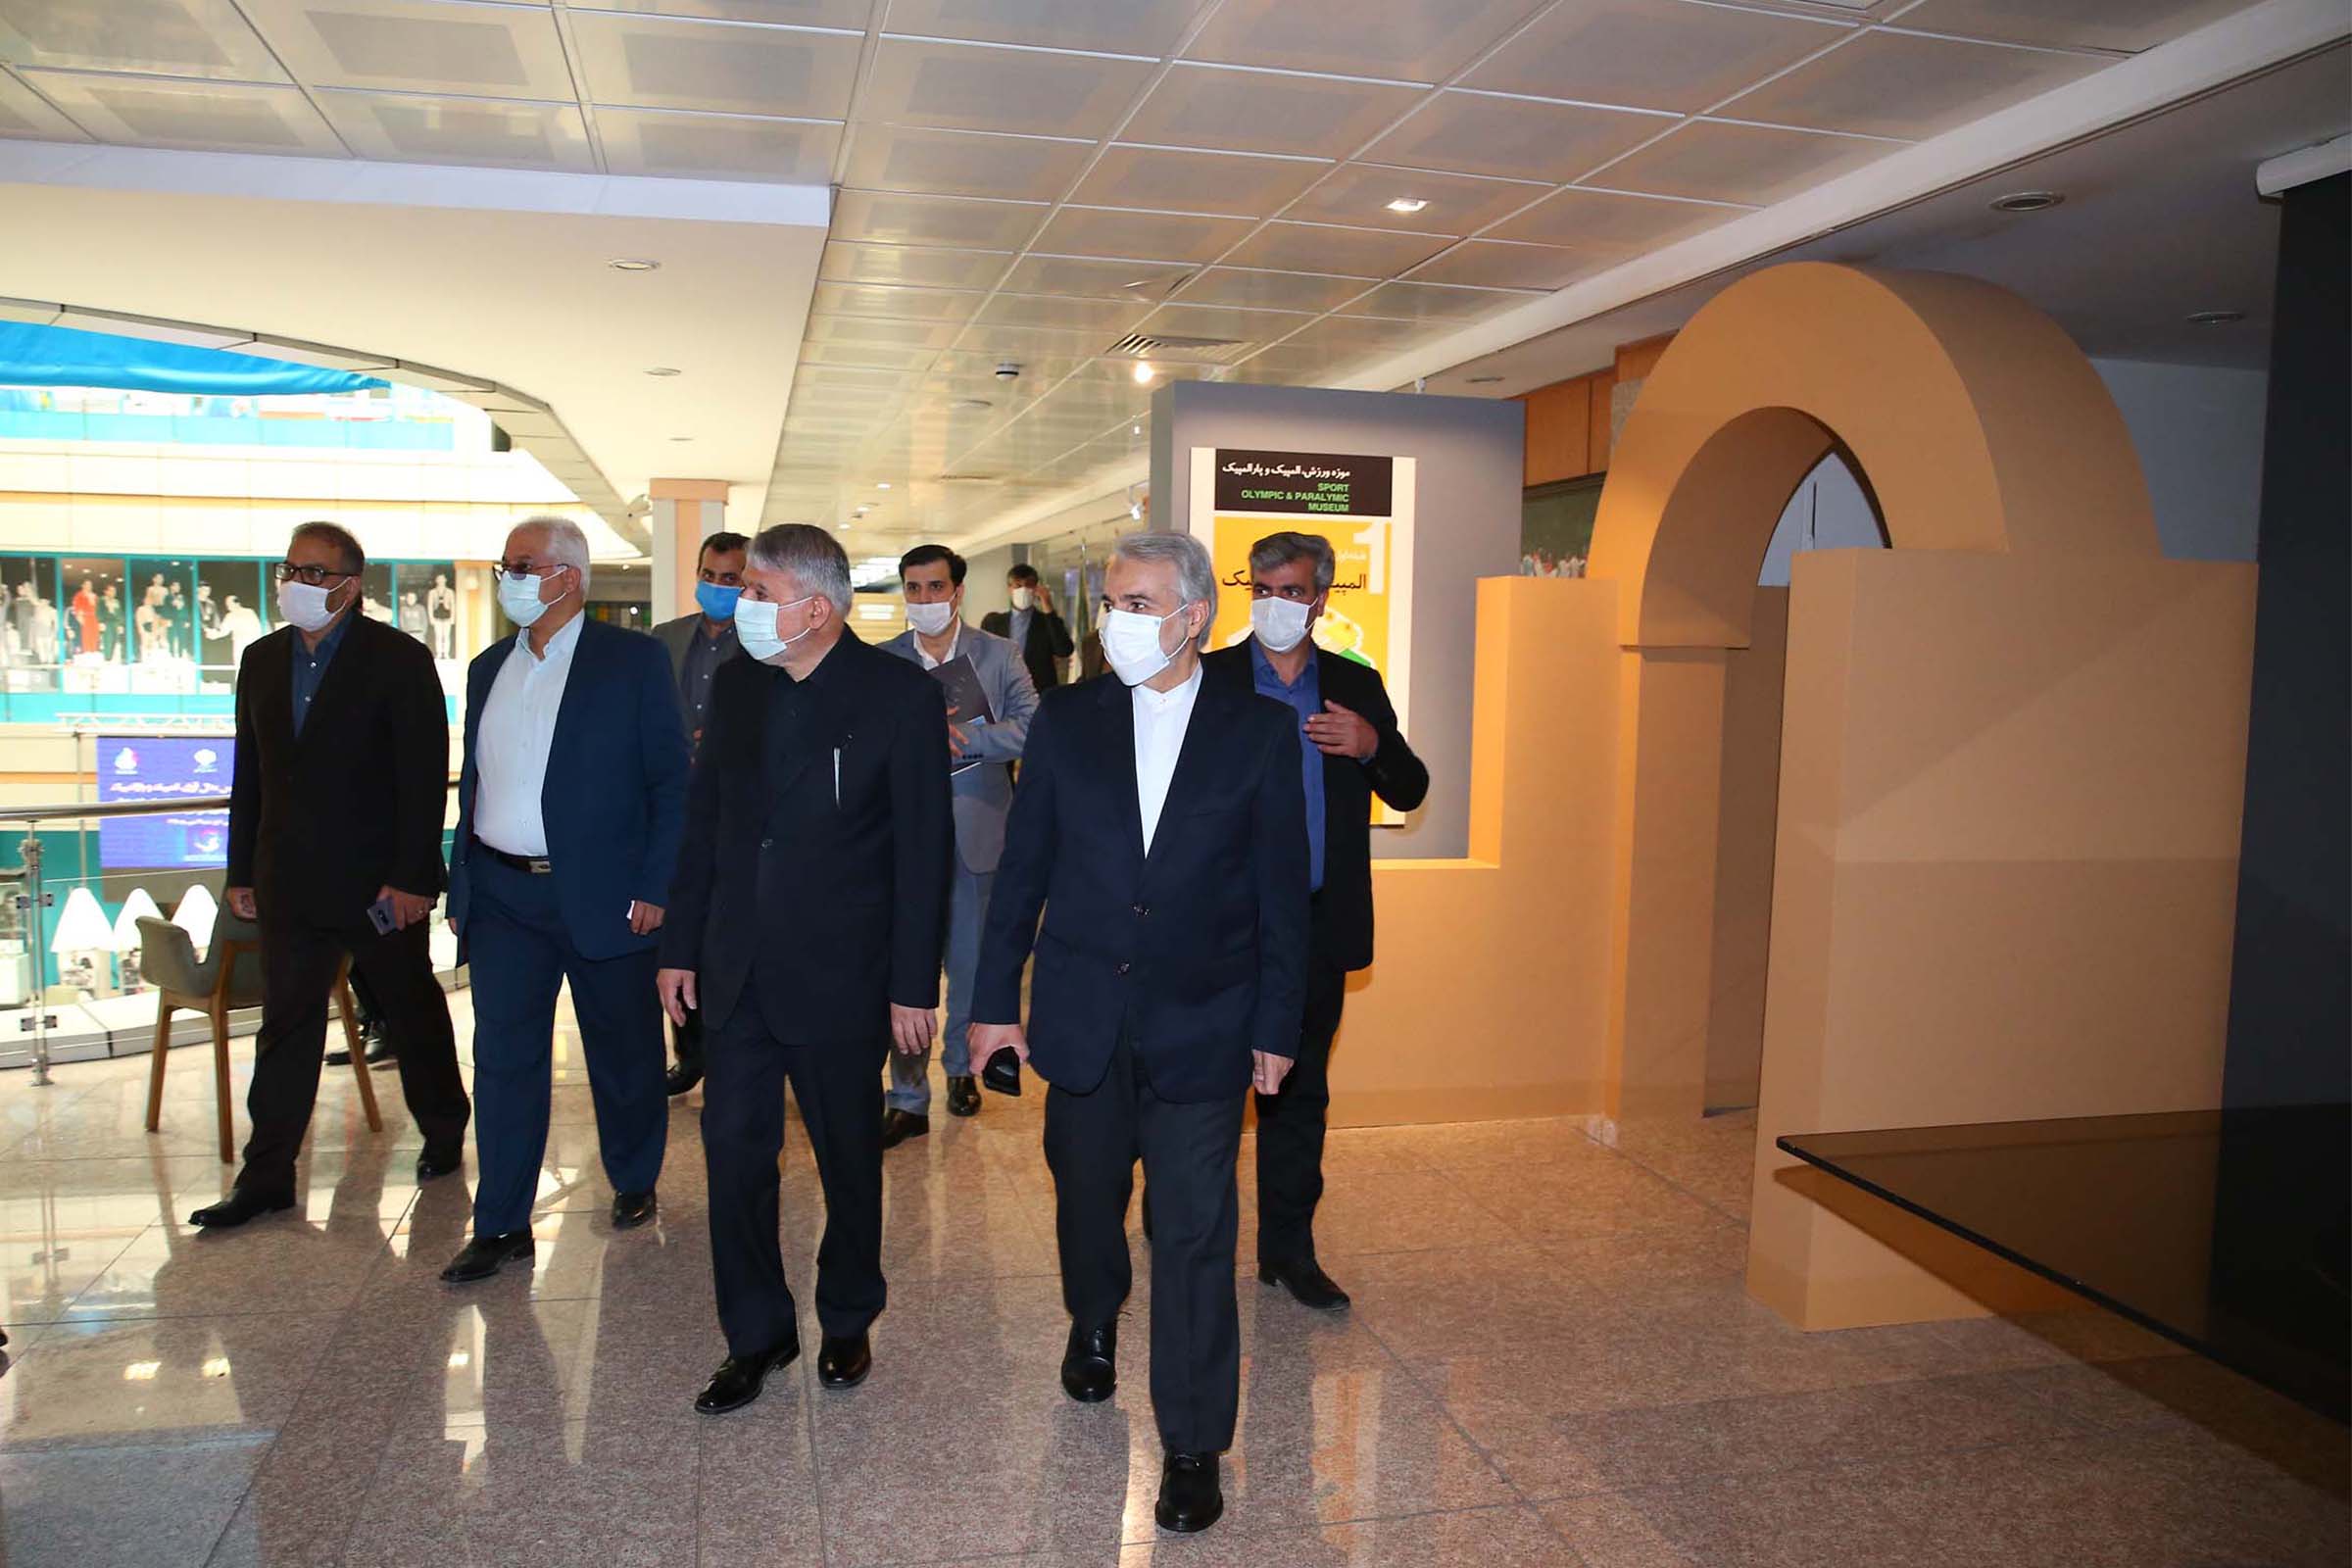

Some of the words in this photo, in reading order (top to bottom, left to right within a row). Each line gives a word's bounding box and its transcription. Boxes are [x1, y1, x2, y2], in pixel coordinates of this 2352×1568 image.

[1222, 462, 1265, 477] پارالمپیک
[1264, 467, 1271, 476] و
[1271, 465, 1301, 478] المپیک
[1331, 467, 1350, 479] موزه
[1317, 482, 1349, 492] SPORT
[1241, 490, 1284, 500] OLYMPIC
[1308, 503, 1349, 512] MUSEUM
